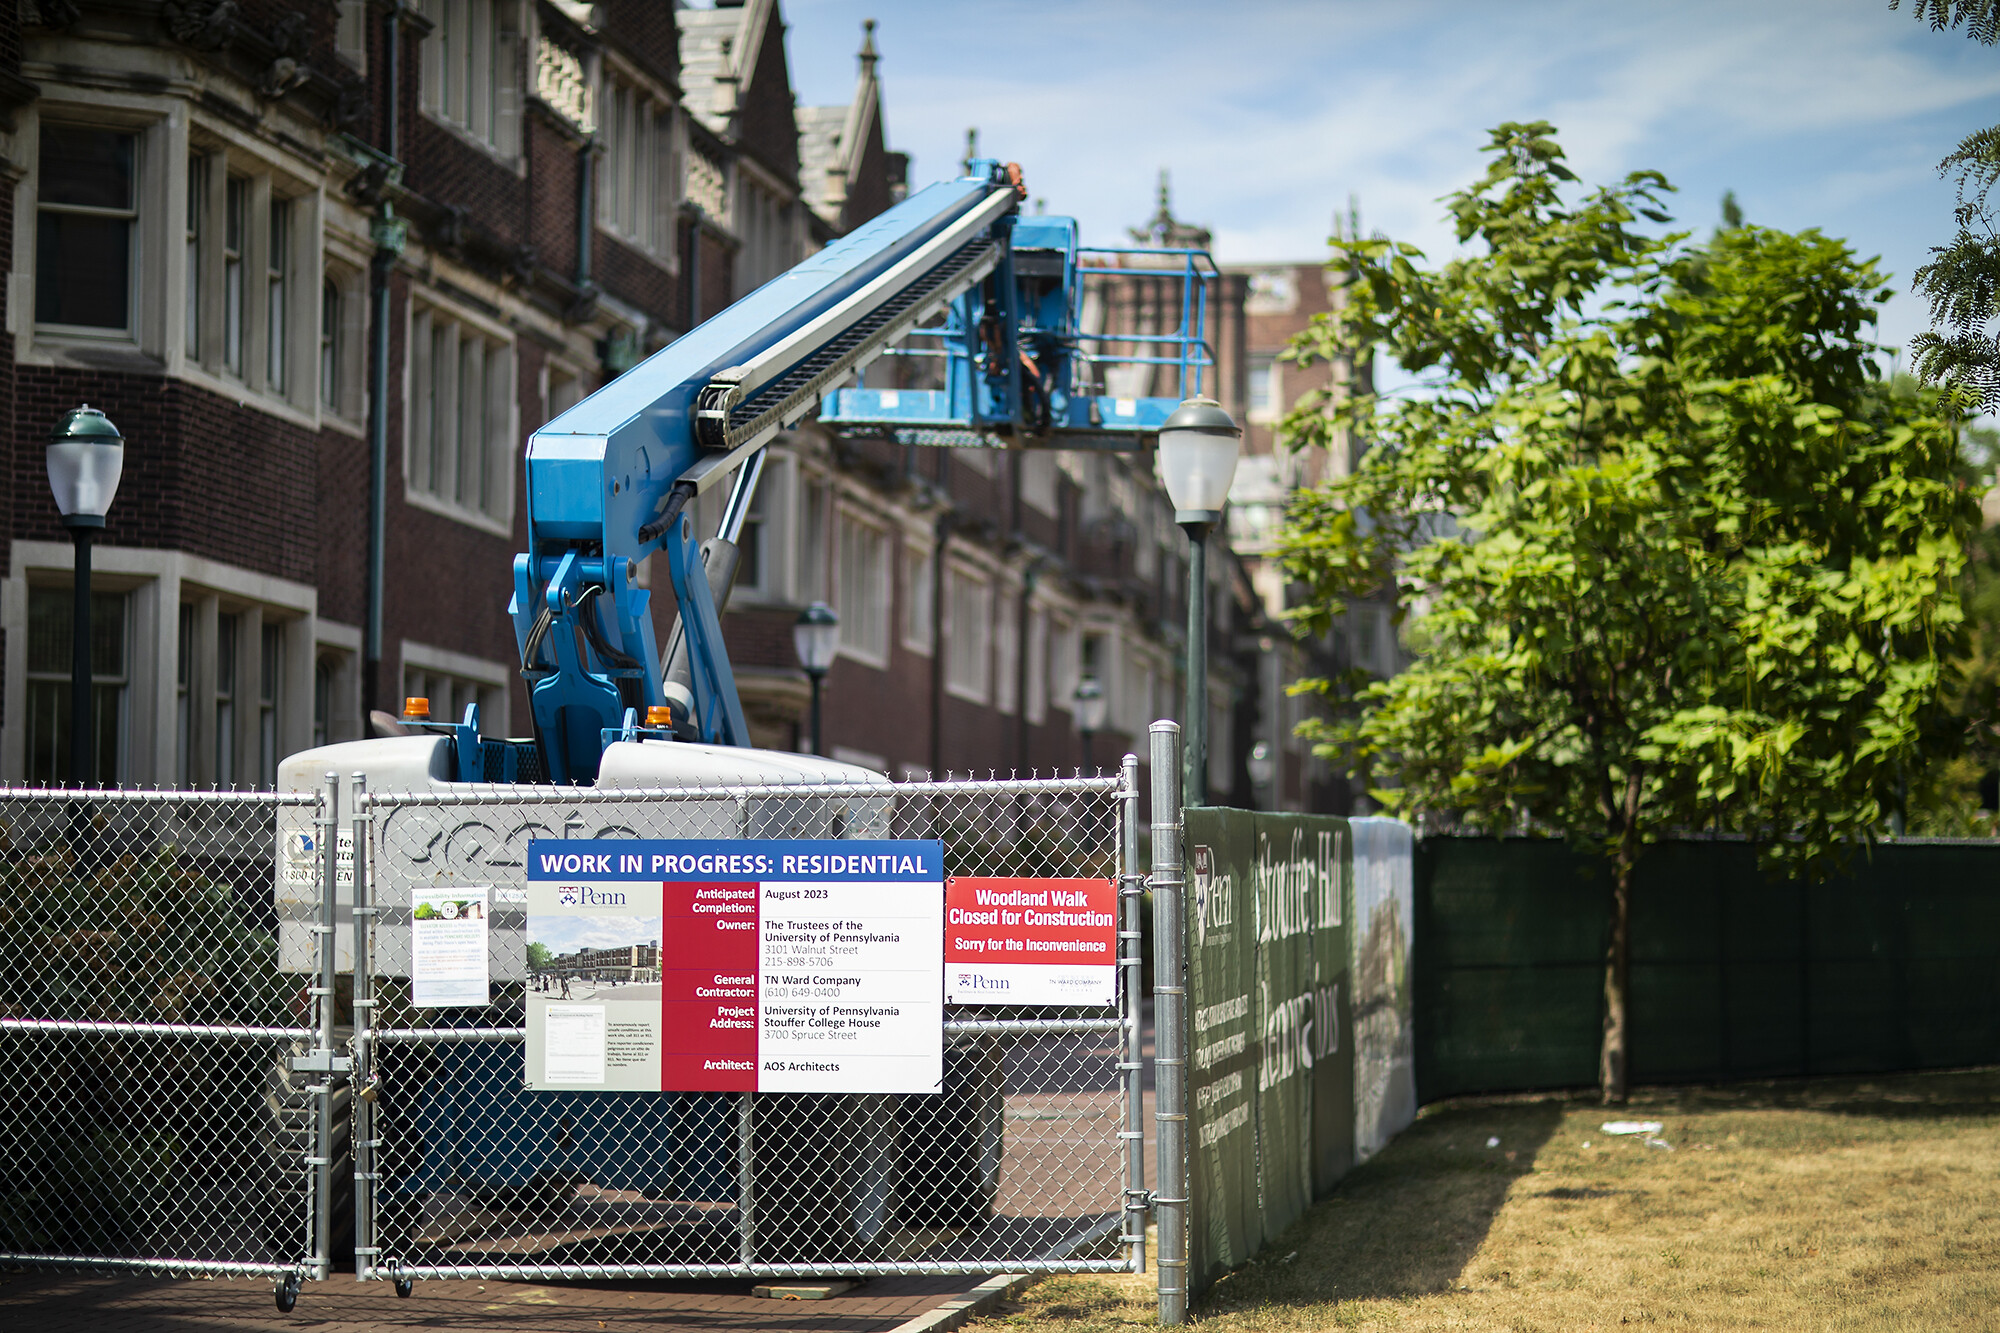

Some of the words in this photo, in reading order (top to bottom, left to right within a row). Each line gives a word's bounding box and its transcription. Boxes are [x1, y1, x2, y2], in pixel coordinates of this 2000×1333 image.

[540, 854, 612, 874] WORK
[619, 854, 643, 874] IN
[651, 853, 774, 874] PROGRESS:
[782, 854, 928, 874] RESIDENTIAL
[580, 886, 626, 905] Penn
[695, 888, 755, 902] Anticipated
[764, 889, 801, 901] August
[803, 889, 829, 899] 2023
[975, 889, 1048, 907] Woodland
[1050, 890, 1088, 907] Walk
[692, 902, 755, 915] Completion:
[949, 908, 998, 925] Closed
[1001, 908, 1022, 925] for
[1024, 908, 1113, 927] Construction
[716, 919, 755, 930] Owner:
[764, 920, 784, 930] The
[786, 920, 830, 931] Trustees
[832, 920, 844, 931] of
[846, 920, 863, 931] the
[764, 932, 817, 944] University
[819, 932, 831, 943] of
[833, 932, 900, 944] Pennsylvania
[764, 944, 788, 955] 3101
[791, 945, 826, 955] Walnut
[829, 944, 859, 955] Street
[954, 937, 985, 953] Sorry
[987, 937, 1003, 951] for
[1005, 938, 1024, 951] the
[1025, 938, 1107, 952] Inconvenience
[764, 956, 834, 967] 215-898-5706
[713, 974, 755, 985] General
[764, 975, 779, 985] TN
[781, 975, 810, 985] Ward
[812, 975, 862, 987] Company
[973, 974, 1010, 989] Penn
[695, 986, 755, 998] Contractor:
[764, 986, 789, 998] (610)
[791, 986, 841, 998] 649-0400
[717, 1005, 755, 1019] Project
[764, 1005, 817, 1017] University
[819, 1005, 830, 1016] of
[832, 1006, 900, 1018] Pennsylvania
[709, 1018, 755, 1029] Address:
[764, 1017, 806, 1028] Stouffer
[808, 1017, 846, 1030] College
[848, 1018, 881, 1029] House
[764, 1029, 789, 1040] 3700
[791, 1029, 825, 1042] Spruce
[827, 1030, 857, 1041] Street
[703, 1059, 755, 1071] Architect:
[763, 1061, 786, 1072] AOS
[788, 1061, 840, 1072] Architects
